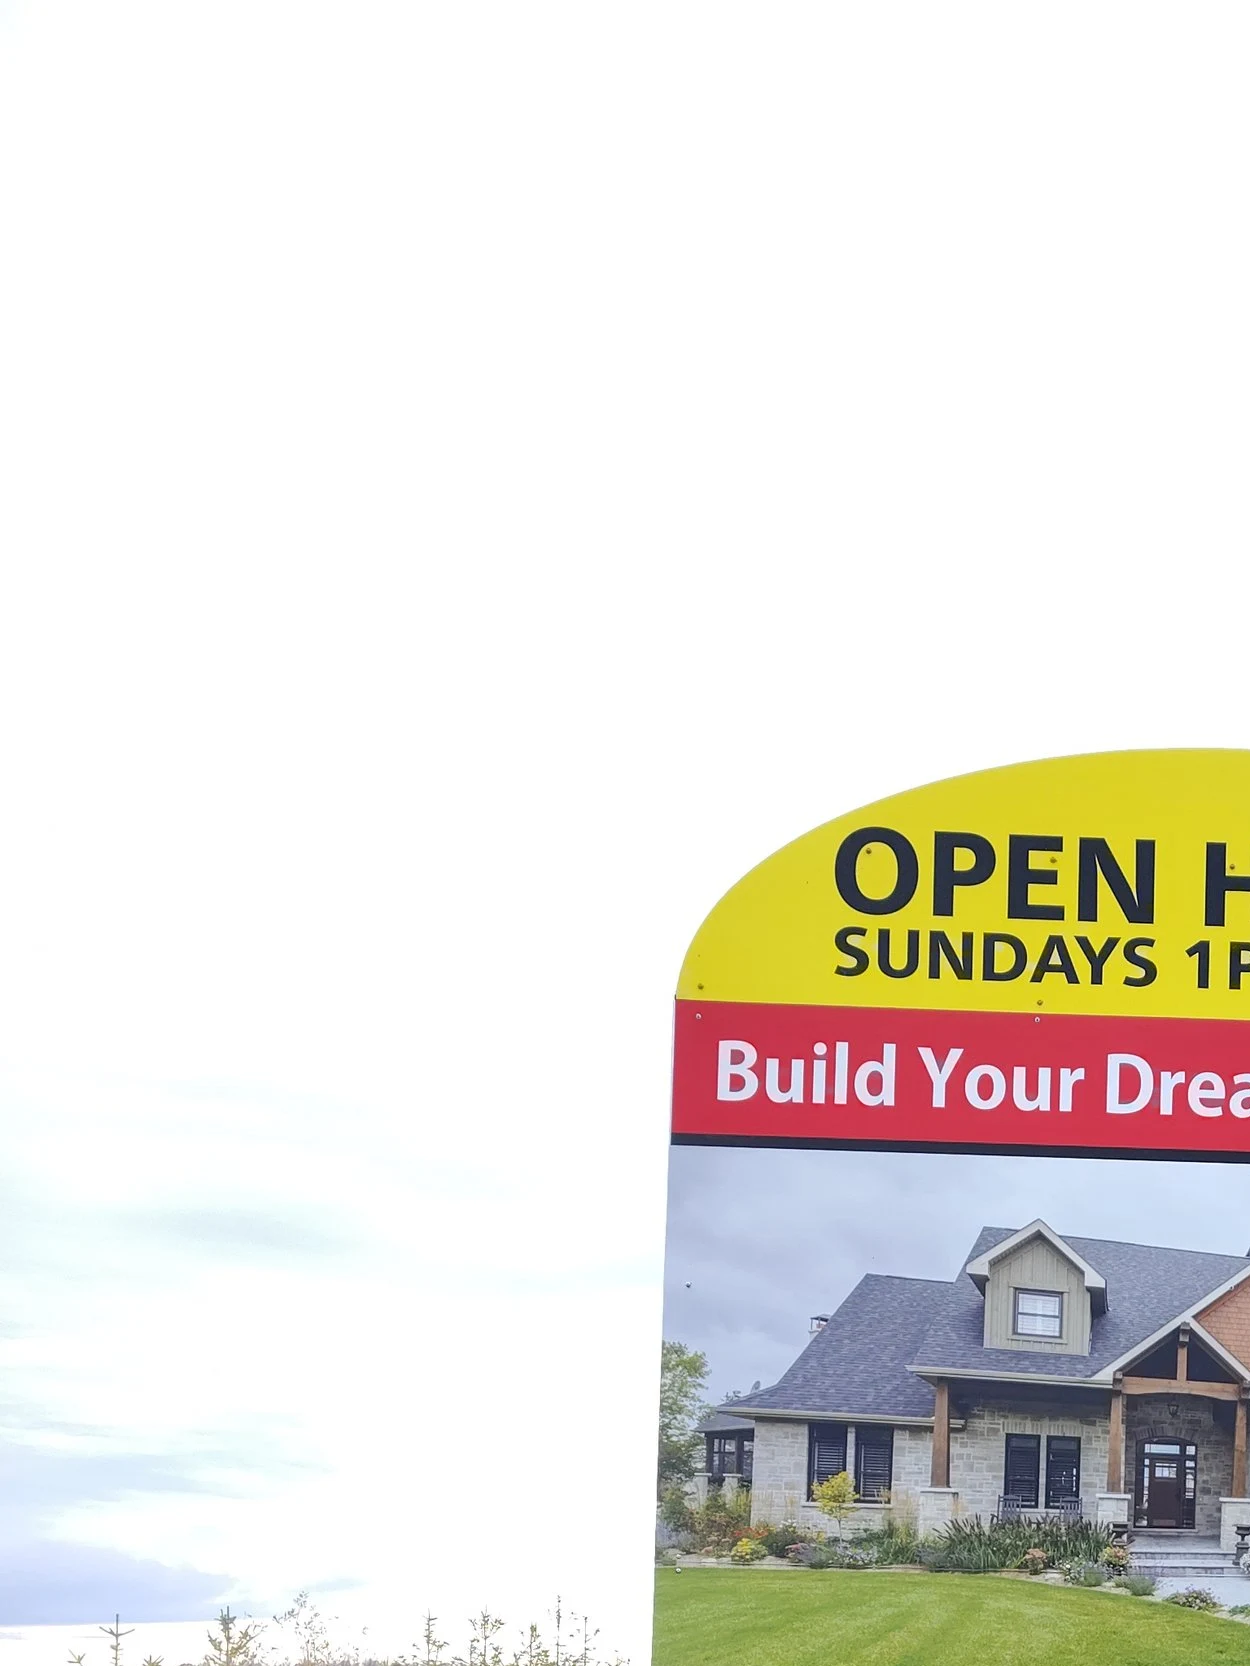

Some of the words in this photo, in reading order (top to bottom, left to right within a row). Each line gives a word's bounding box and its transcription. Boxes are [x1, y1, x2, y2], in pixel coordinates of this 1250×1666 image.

[834, 827, 1156, 925] OPEN
[834, 927, 1158, 987] SUNDAYS
[716, 1039, 897, 1108] Build
[917, 1046, 1084, 1113] Your
